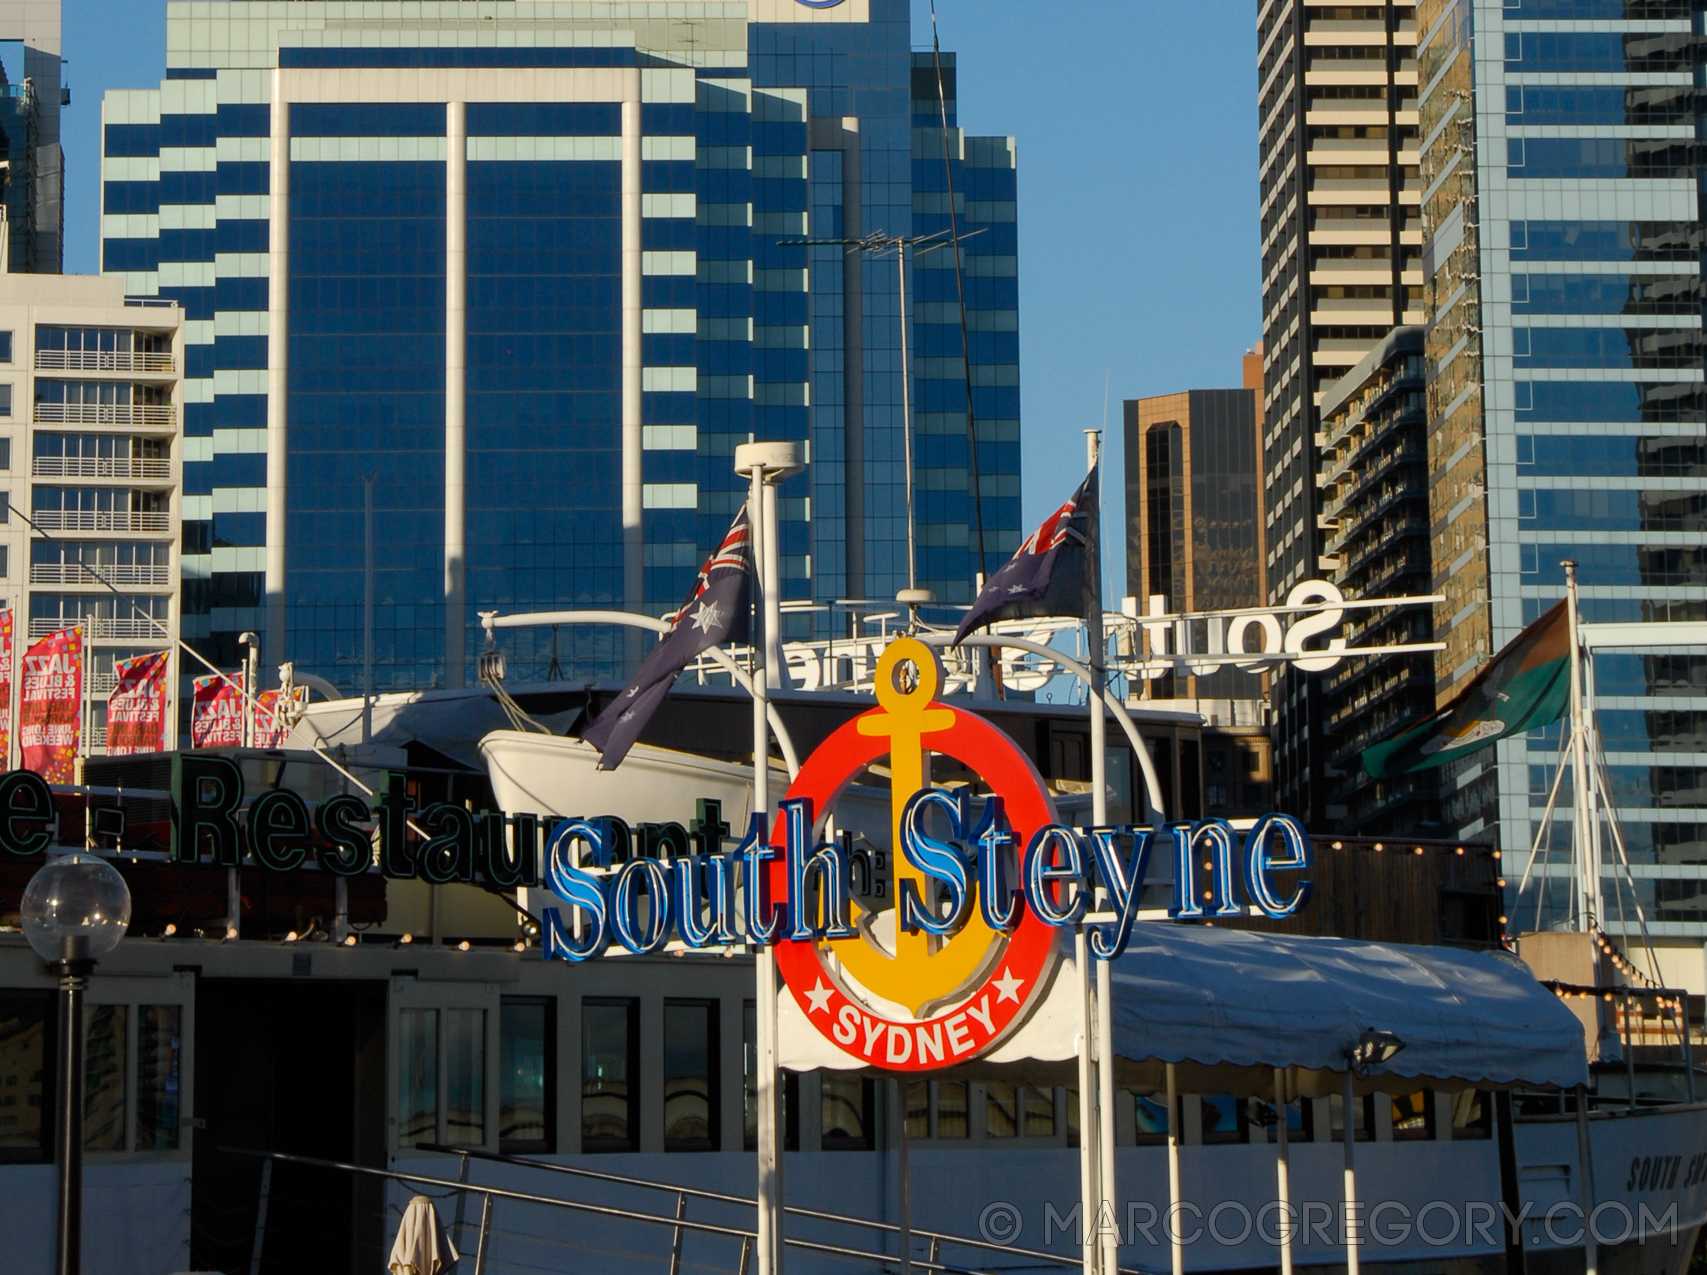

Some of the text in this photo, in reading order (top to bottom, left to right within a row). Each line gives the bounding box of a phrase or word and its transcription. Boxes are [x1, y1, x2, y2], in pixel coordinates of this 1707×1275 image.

[542, 785, 1314, 962] South Steyne
[832, 994, 997, 1065] SYDNEY
[1627, 1155, 1682, 1192] SOUTH
